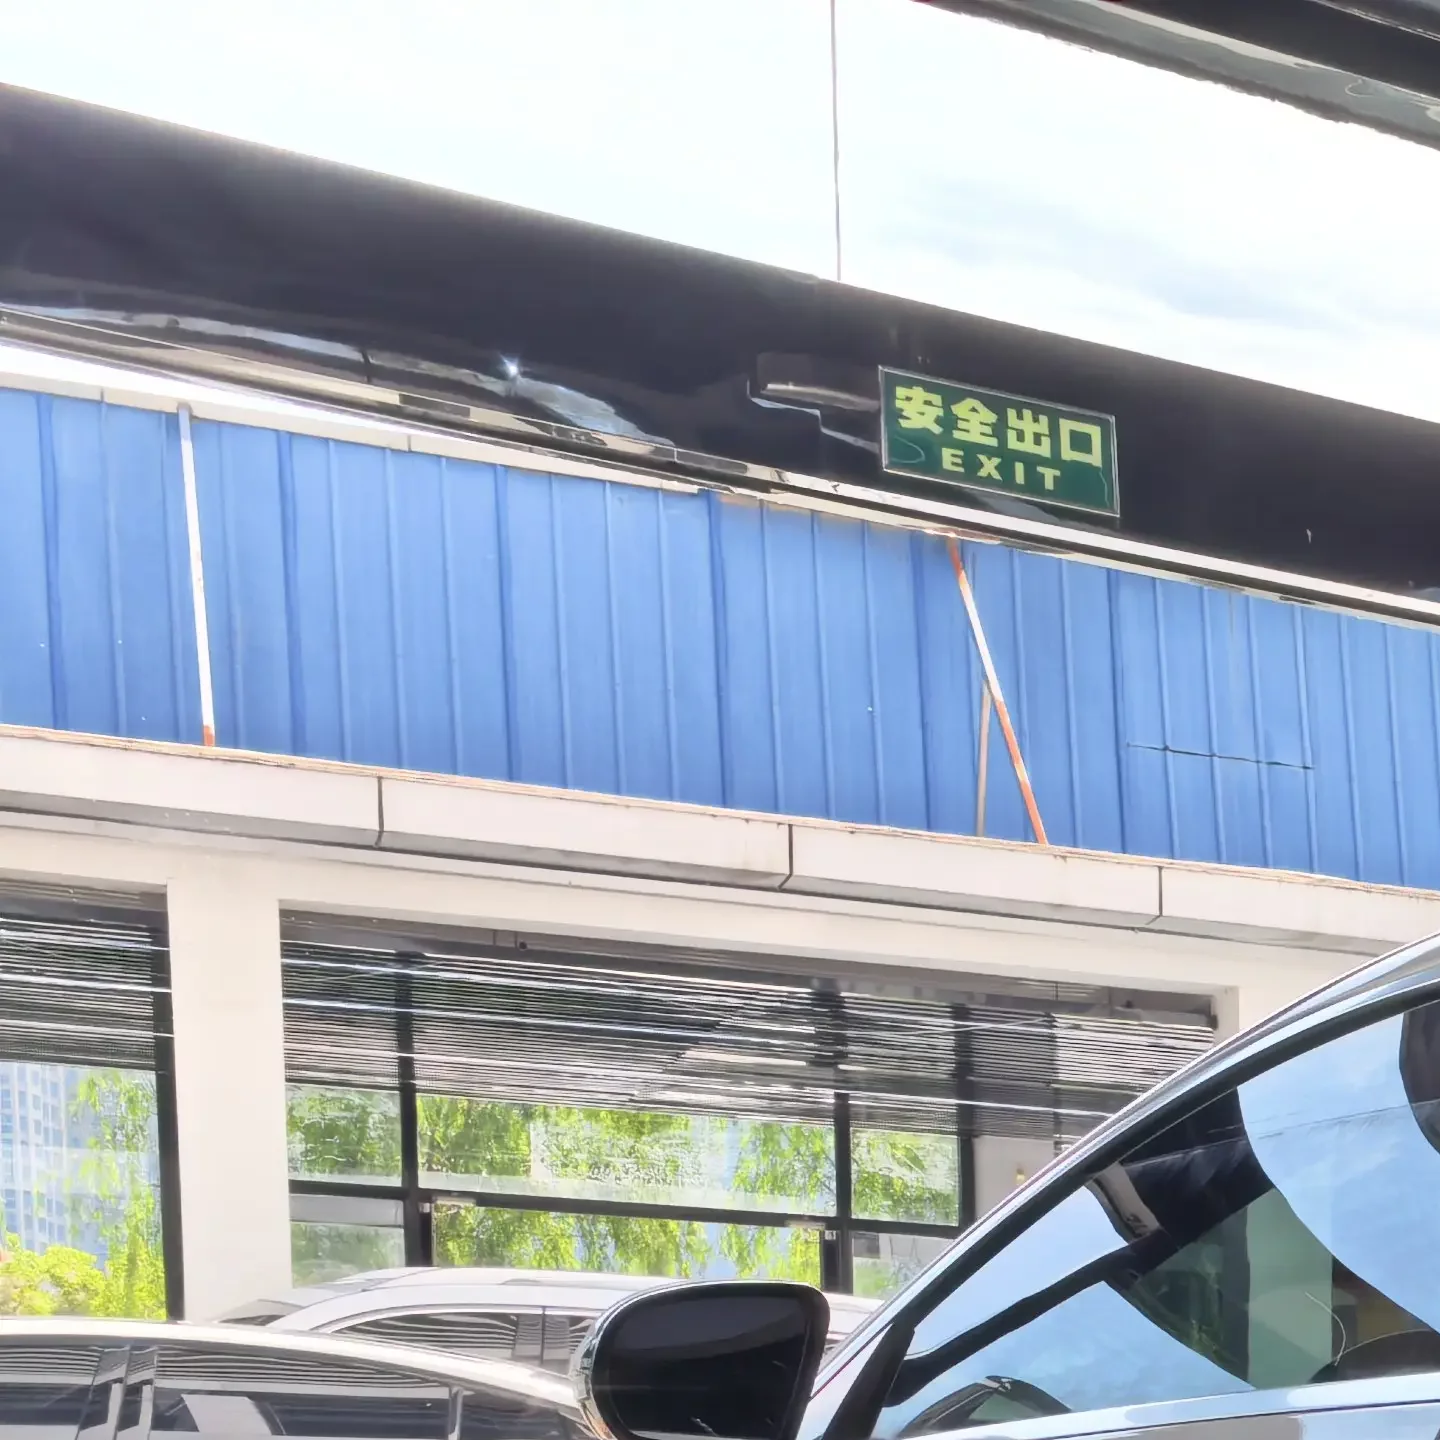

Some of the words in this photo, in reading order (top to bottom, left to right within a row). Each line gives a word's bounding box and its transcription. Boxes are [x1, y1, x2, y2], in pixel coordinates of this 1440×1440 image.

[895, 385, 1102, 467] 安全出口
[942, 447, 1060, 491] EXIT
